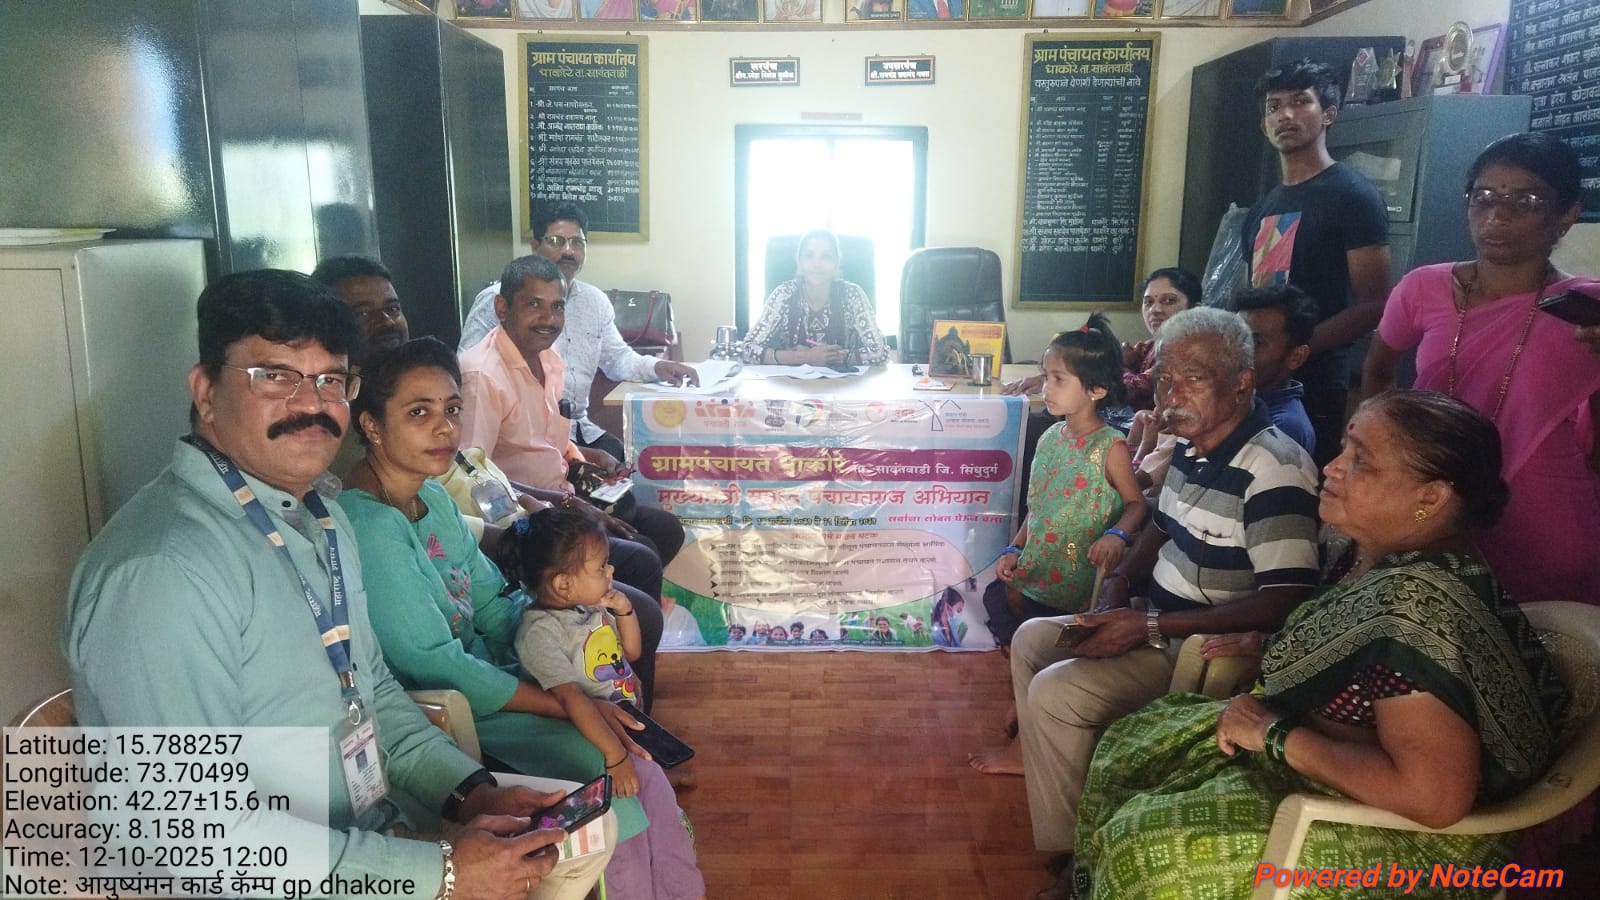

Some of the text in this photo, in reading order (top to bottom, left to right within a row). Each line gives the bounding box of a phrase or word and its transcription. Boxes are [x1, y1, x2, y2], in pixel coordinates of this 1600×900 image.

[531, 48, 637, 66] ग्राम पंचायत कार्यालय
[1033, 42, 1151, 63] ग्राम पंचायत कार्यालय
[539, 65, 574, 78] धाकोरे
[1045, 62, 1078, 74] धाकोरे
[651, 450, 770, 473] ग्रामपंचायत
[876, 462, 930, 477] सावंतवाडी
[935, 463, 954, 475] जि.
[960, 463, 998, 478] सिंधुदुर्ग
[657, 482, 741, 511] मुख्यमंत्री
[913, 484, 991, 506] अभियान
